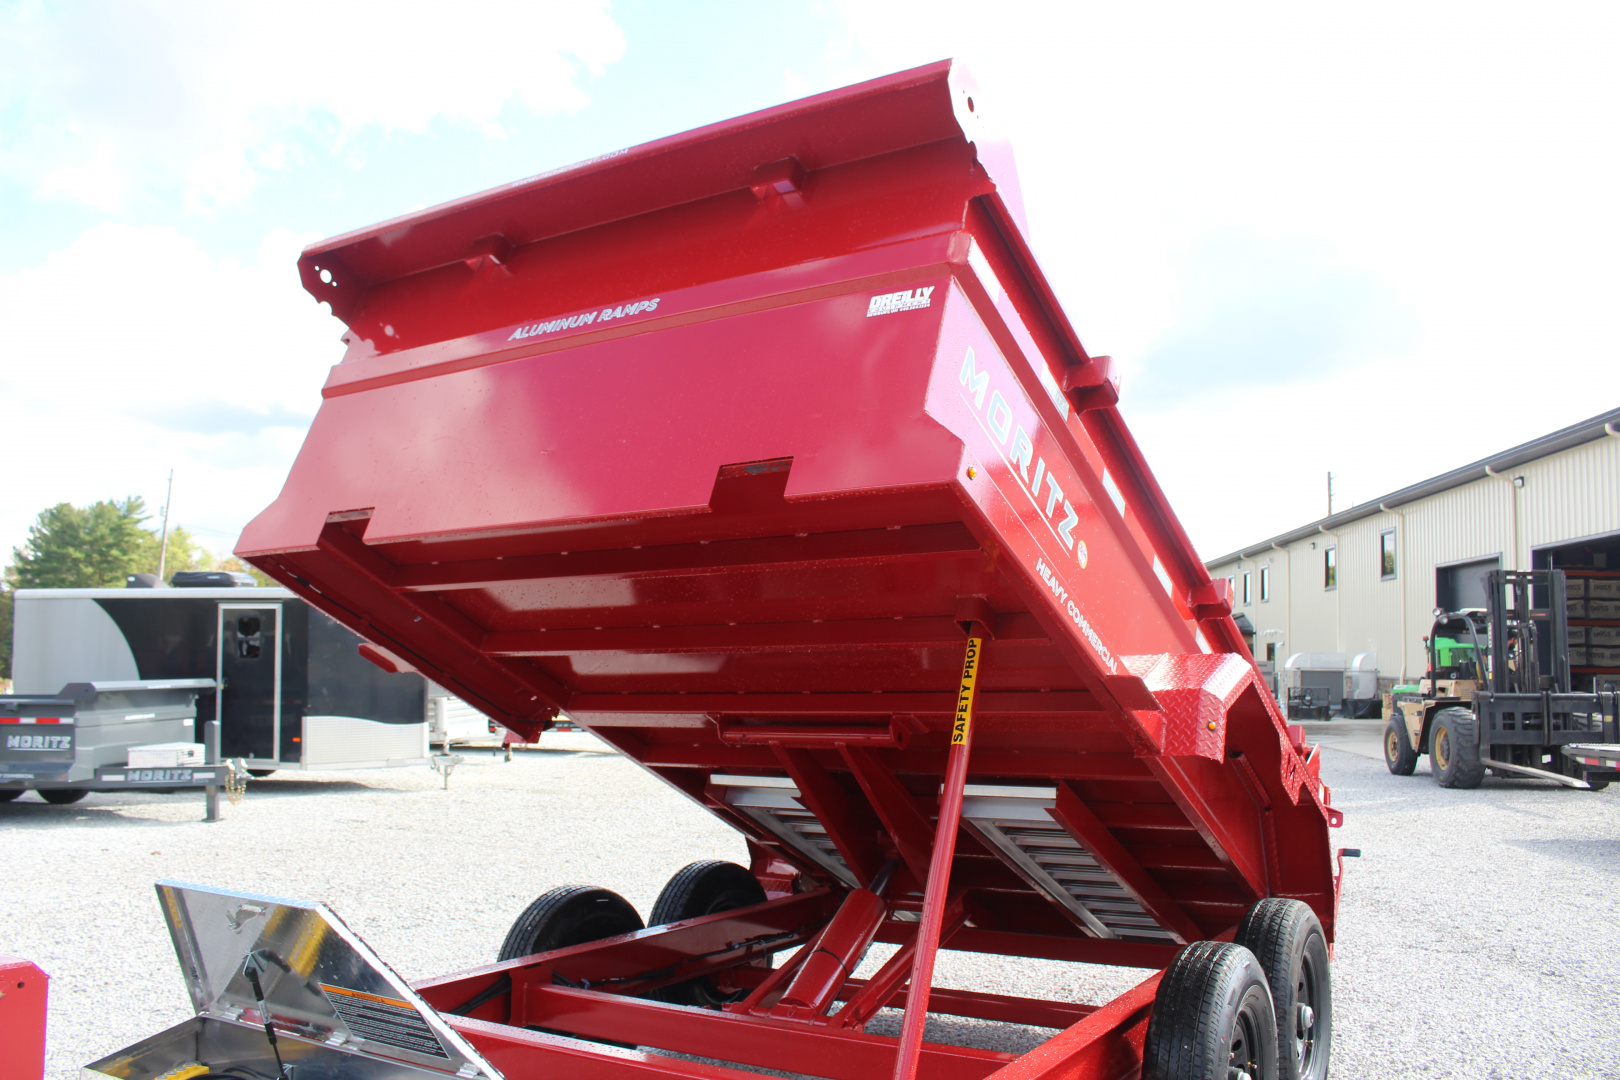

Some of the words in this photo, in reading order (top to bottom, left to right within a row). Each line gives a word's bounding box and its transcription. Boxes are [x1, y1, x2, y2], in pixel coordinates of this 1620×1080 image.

[869, 286, 935, 309] OREILLY
[507, 311, 598, 341] ALUMINUM
[597, 298, 660, 322] RAMPS
[958, 345, 1079, 550] MORITZ
[1035, 557, 1068, 604] HEAVY
[1067, 600, 1118, 675] COMMERCIAL
[953, 684, 971, 743] SAFETY
[963, 639, 977, 679] PROP
[7, 735, 71, 749] MORITZ
[127, 769, 193, 781] MORITZ
